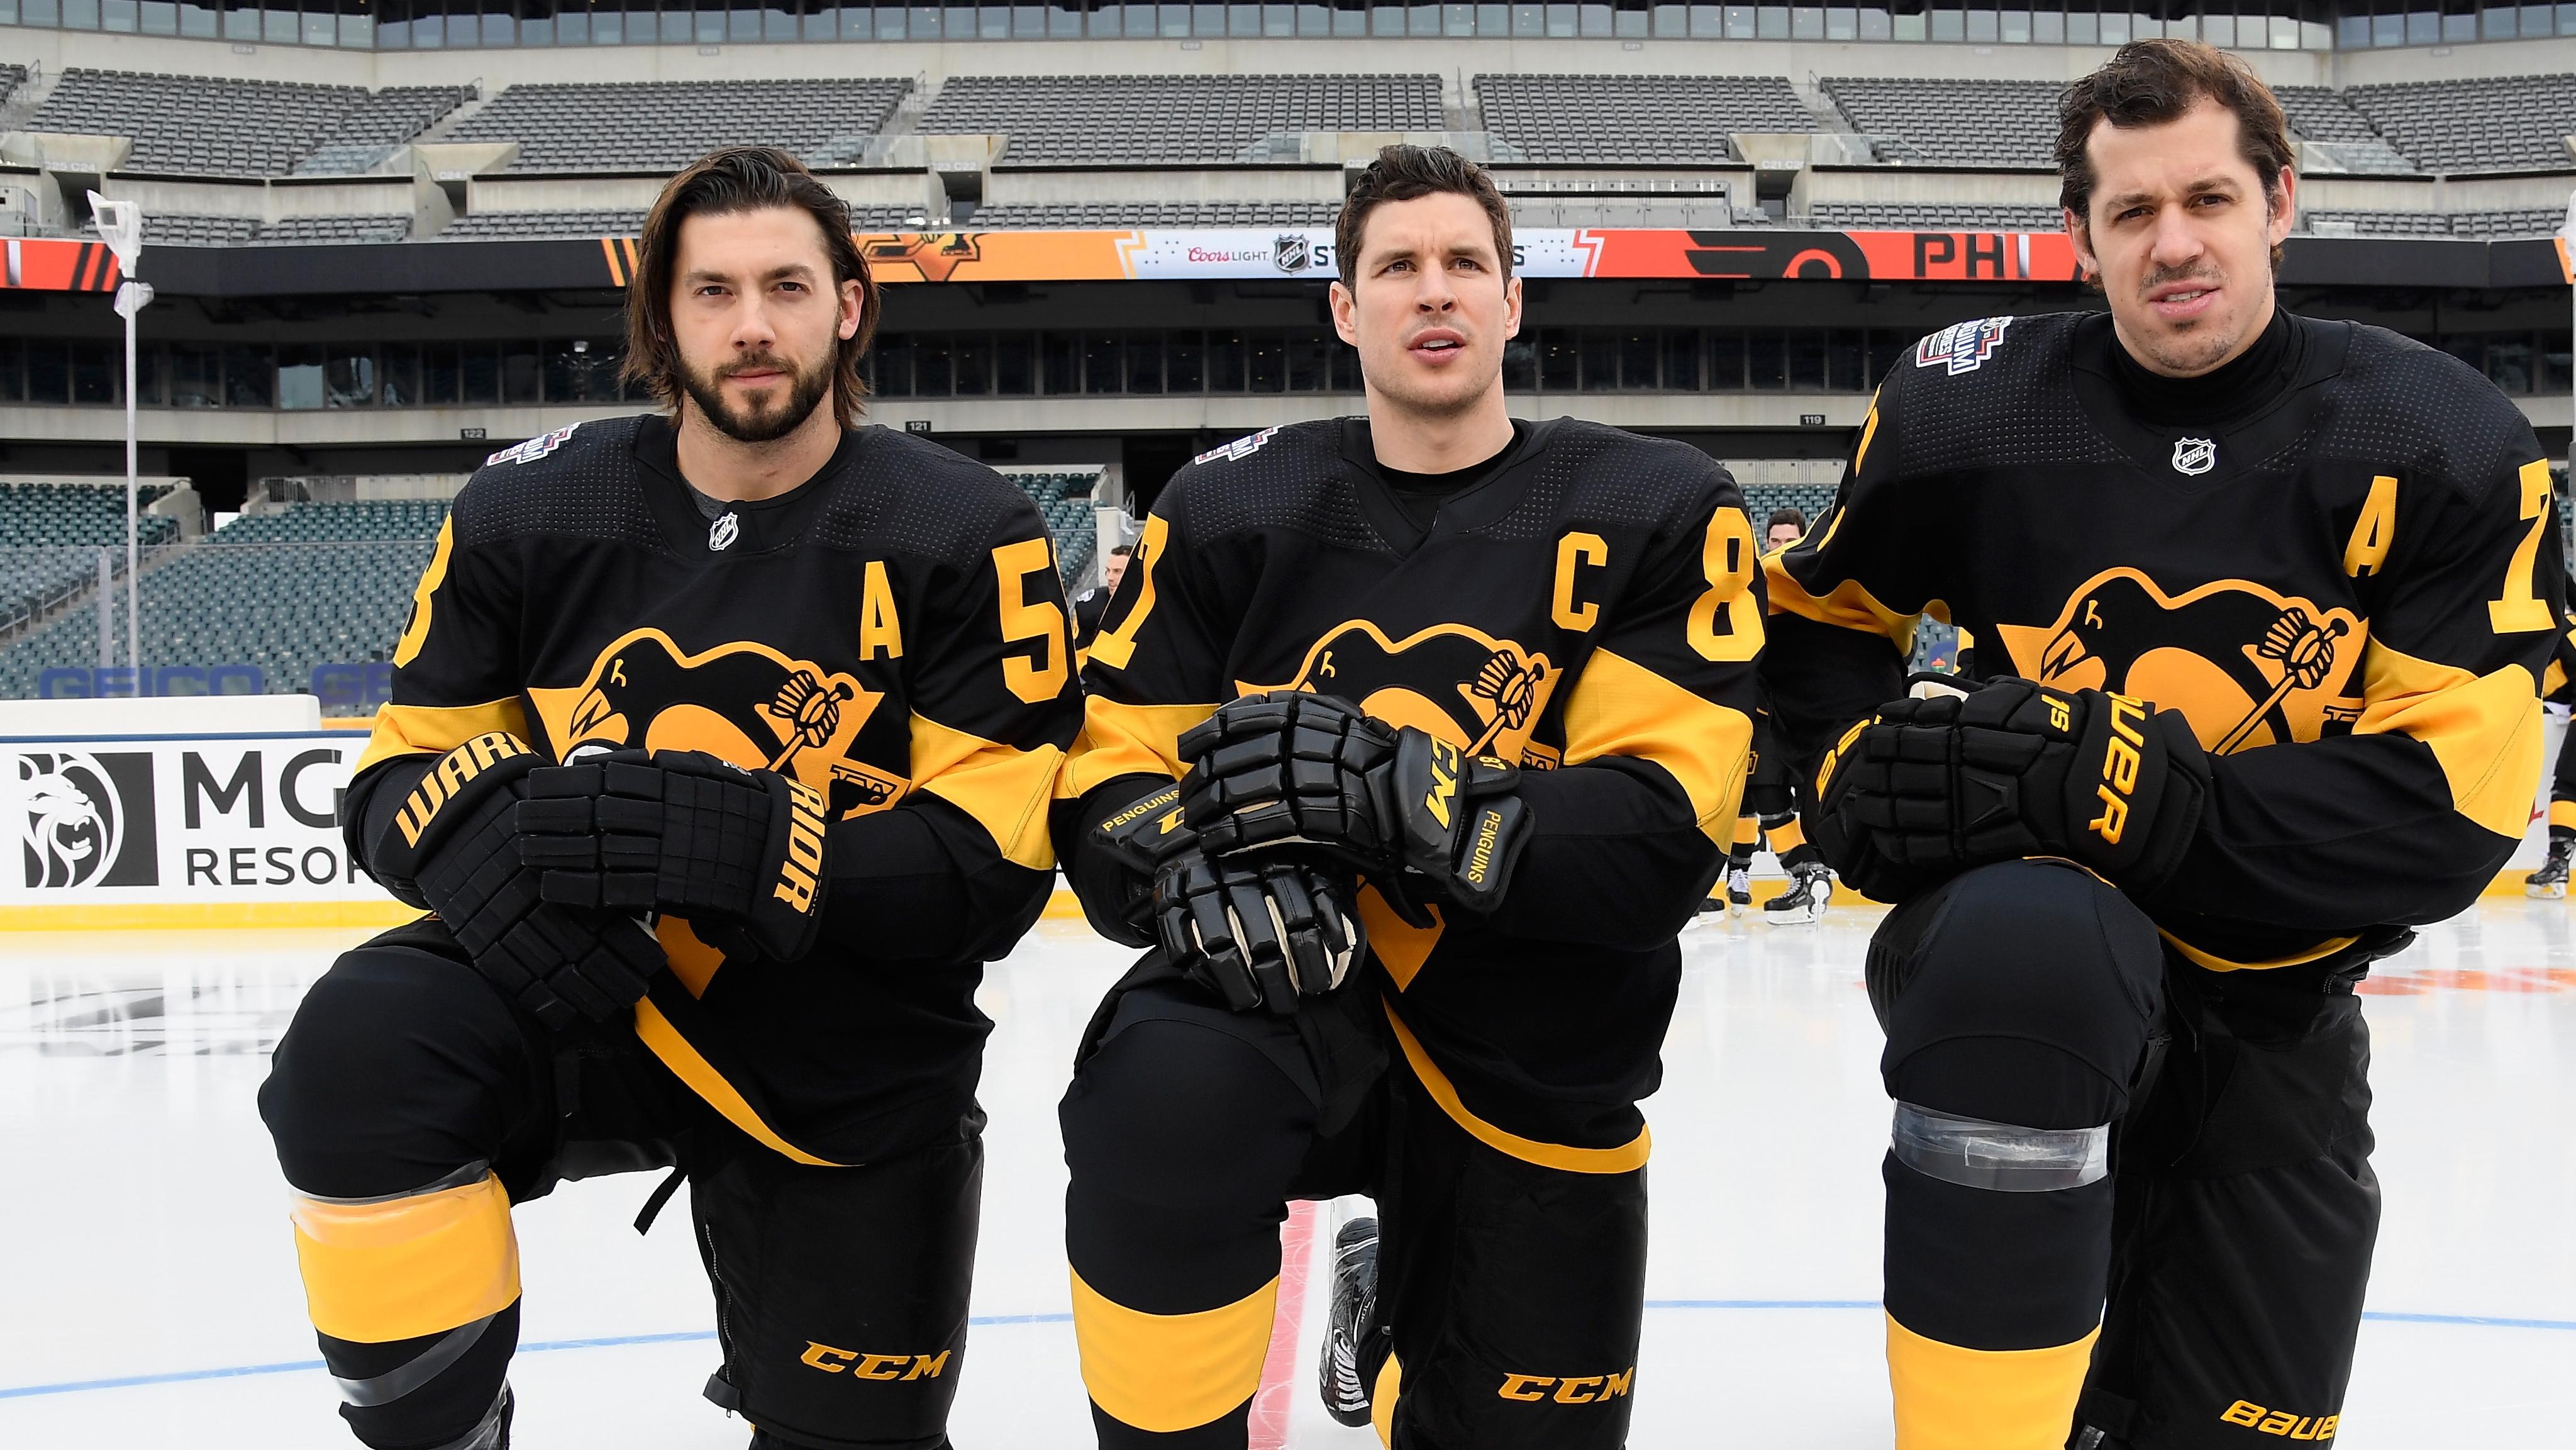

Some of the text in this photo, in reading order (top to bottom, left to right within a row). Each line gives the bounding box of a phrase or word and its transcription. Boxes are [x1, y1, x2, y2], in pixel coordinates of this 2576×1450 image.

[1188, 247, 1269, 262] Coors LIGHT
[464, 430, 484, 438] 122
[909, 422, 928, 432] 121
[1804, 416, 1823, 425] 119
[2343, 476, 2398, 577] A
[1551, 531, 1608, 633] C
[1687, 506, 1766, 662] 8
[858, 560, 903, 661] A
[991, 537, 1069, 704] 5
[1478, 756, 1507, 771] 87
[1101, 789, 1179, 832] PENGUINS
[1467, 810, 1502, 884] PENGUINS
[800, 1340, 952, 1381] CCM
[1497, 1366, 1634, 1404] CCM
